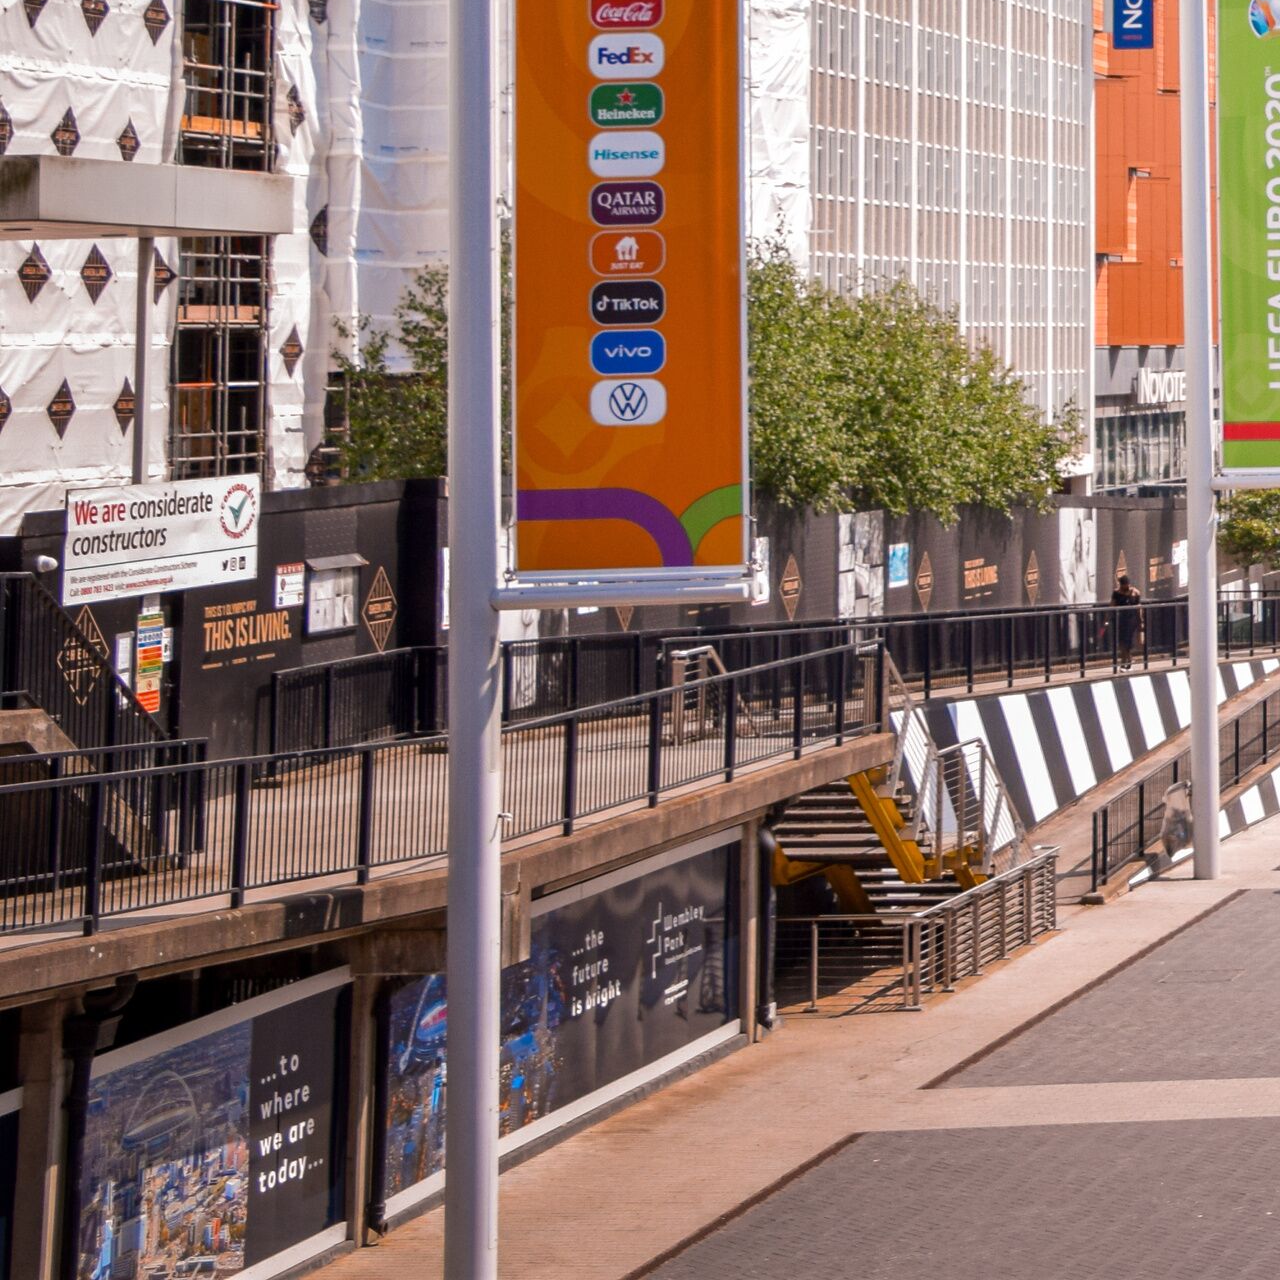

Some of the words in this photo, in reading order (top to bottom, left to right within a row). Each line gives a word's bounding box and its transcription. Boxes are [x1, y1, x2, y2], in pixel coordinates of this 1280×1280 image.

[596, 2, 655, 23] Coca-Cola
[598, 47, 654, 65] FedEx
[597, 107, 656, 121] Heineken
[594, 147, 659, 162] Hisense
[598, 191, 655, 208] QATAR
[611, 204, 657, 217] AIRWAYS
[612, 297, 659, 311] TikTok
[605, 345, 652, 358] vivo
[1138, 367, 1186, 404] NOVOTE
[75, 500, 98, 526] We
[102, 502, 126, 523] are
[130, 491, 213, 520] considerate
[72, 527, 167, 557] constructors
[203, 618, 234, 652] THIS
[235, 615, 248, 647] IS
[248, 610, 292, 645] LIVING.
[664, 905, 704, 932] Wembley
[664, 931, 684, 953] Park
[573, 958, 609, 986] future
[572, 996, 583, 1016] is
[585, 979, 621, 1010] bright
[261, 1085, 310, 1120] where
[260, 1132, 282, 1157] we
[289, 1118, 315, 1144] are
